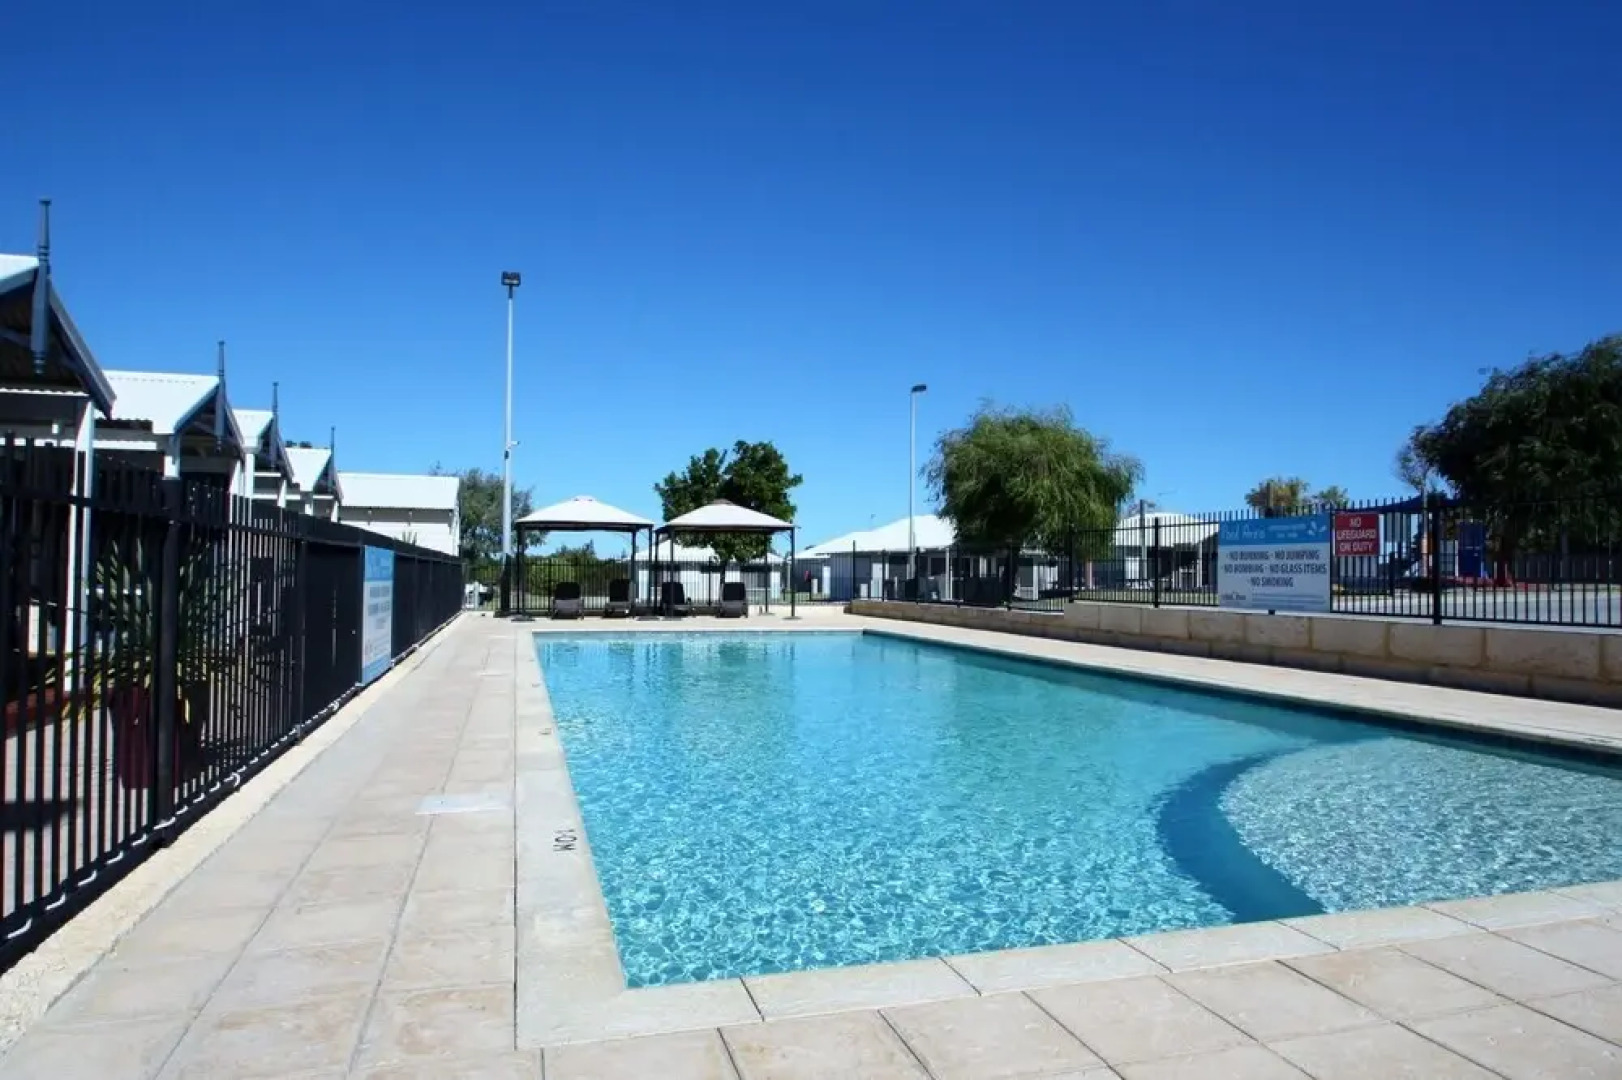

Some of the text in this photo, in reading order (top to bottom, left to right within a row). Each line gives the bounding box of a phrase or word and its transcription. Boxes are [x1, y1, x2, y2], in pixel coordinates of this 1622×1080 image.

[1350, 517, 1361, 528] NO
[1336, 529, 1376, 540] LIFEGUARD
[1339, 541, 1373, 552] ON DUTY
[1229, 551, 1238, 560] NO
[1274, 550, 1285, 560] NO
[1286, 550, 1320, 560] JUMPING
[1224, 564, 1233, 574] NO
[1269, 564, 1279, 574] NO
[1280, 564, 1302, 574] GLASS
[1303, 563, 1327, 574] ITEMS
[1250, 577, 1294, 587] NO SMOKING
